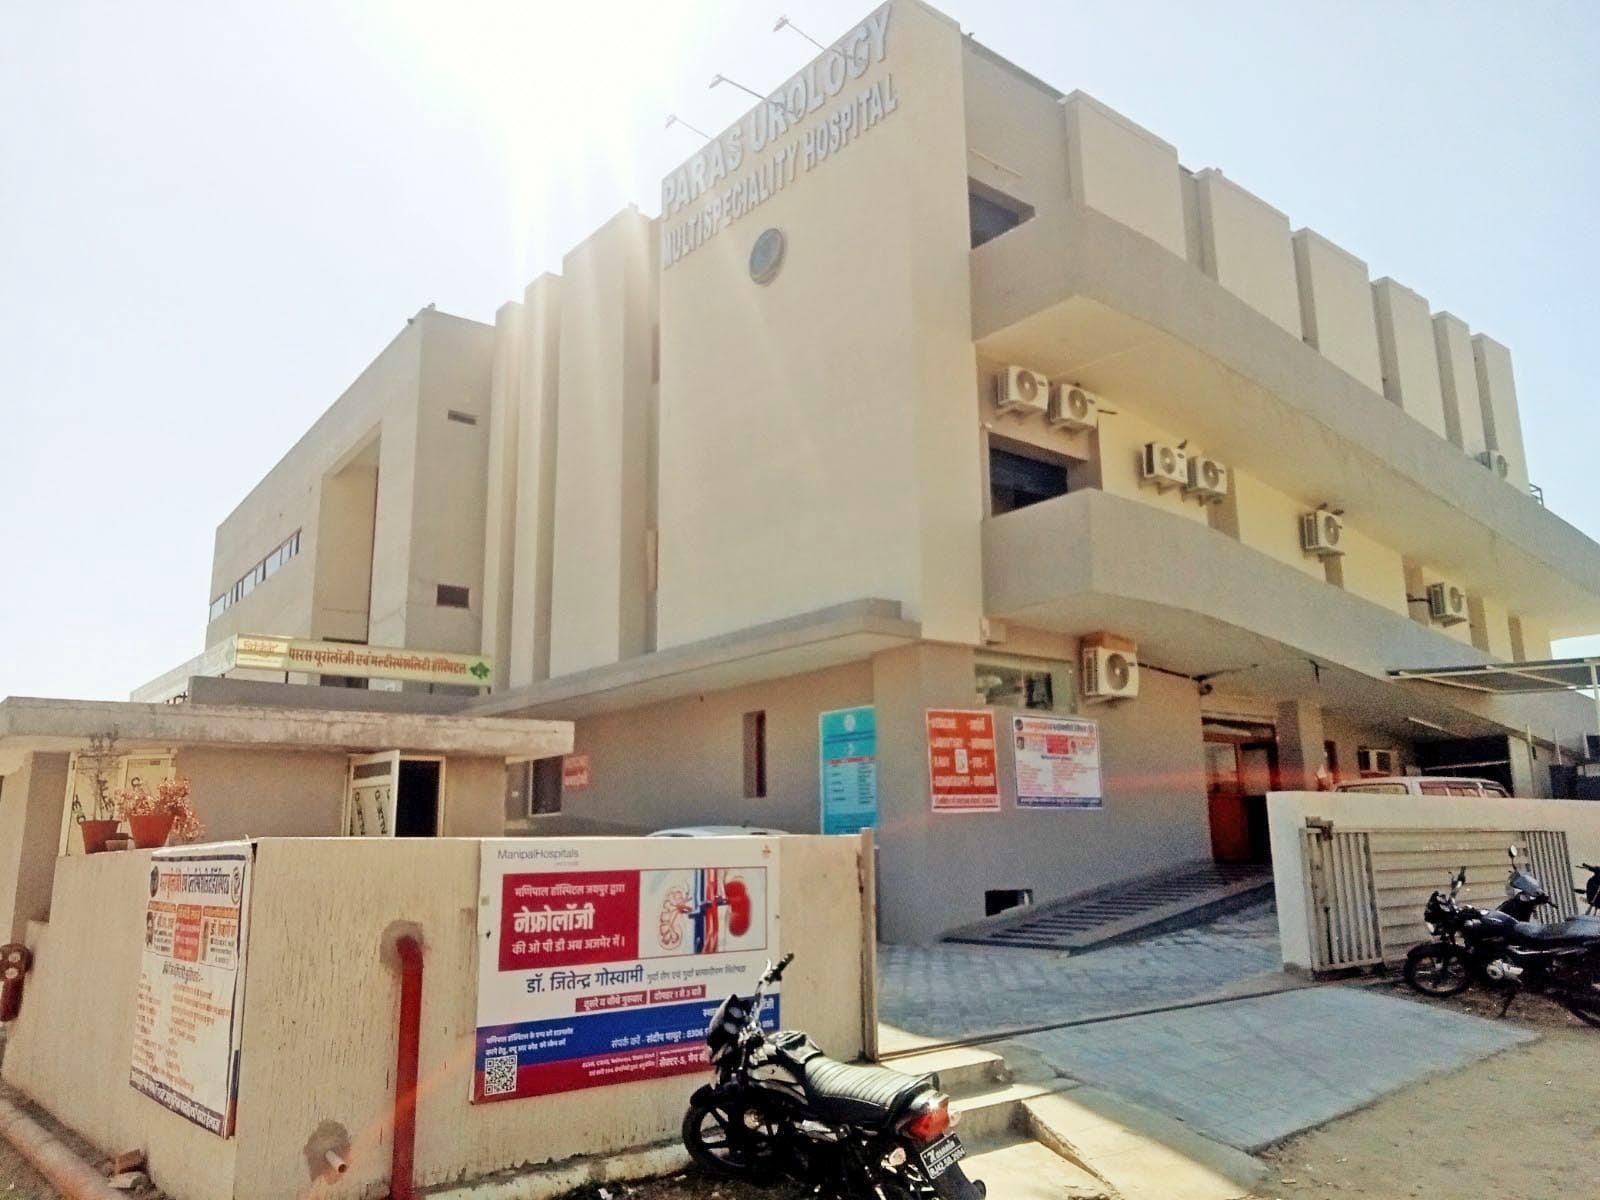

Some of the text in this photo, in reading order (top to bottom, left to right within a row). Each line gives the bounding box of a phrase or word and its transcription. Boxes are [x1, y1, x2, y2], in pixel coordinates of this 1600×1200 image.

[661, 3, 893, 222] PARAS UROLOGY
[803, 72, 898, 172] HOSPITAL
[288, 646, 312, 662] पारस
[356, 651, 369, 667] एवं
[514, 885, 549, 897] मणिपाल
[551, 883, 584, 896] हॉस्पिटल
[585, 884, 609, 897] जयपुर
[513, 902, 595, 934] नेफ्रोलॉजी
[512, 942, 526, 956] की
[528, 940, 540, 954] ओ
[542, 939, 553, 953] पी
[555, 938, 565, 952] डी
[567, 939, 583, 952] अब
[584, 936, 611, 949] अजमेर
[526, 964, 644, 994] डॉ. जितेन्द्र गोस्वामी
